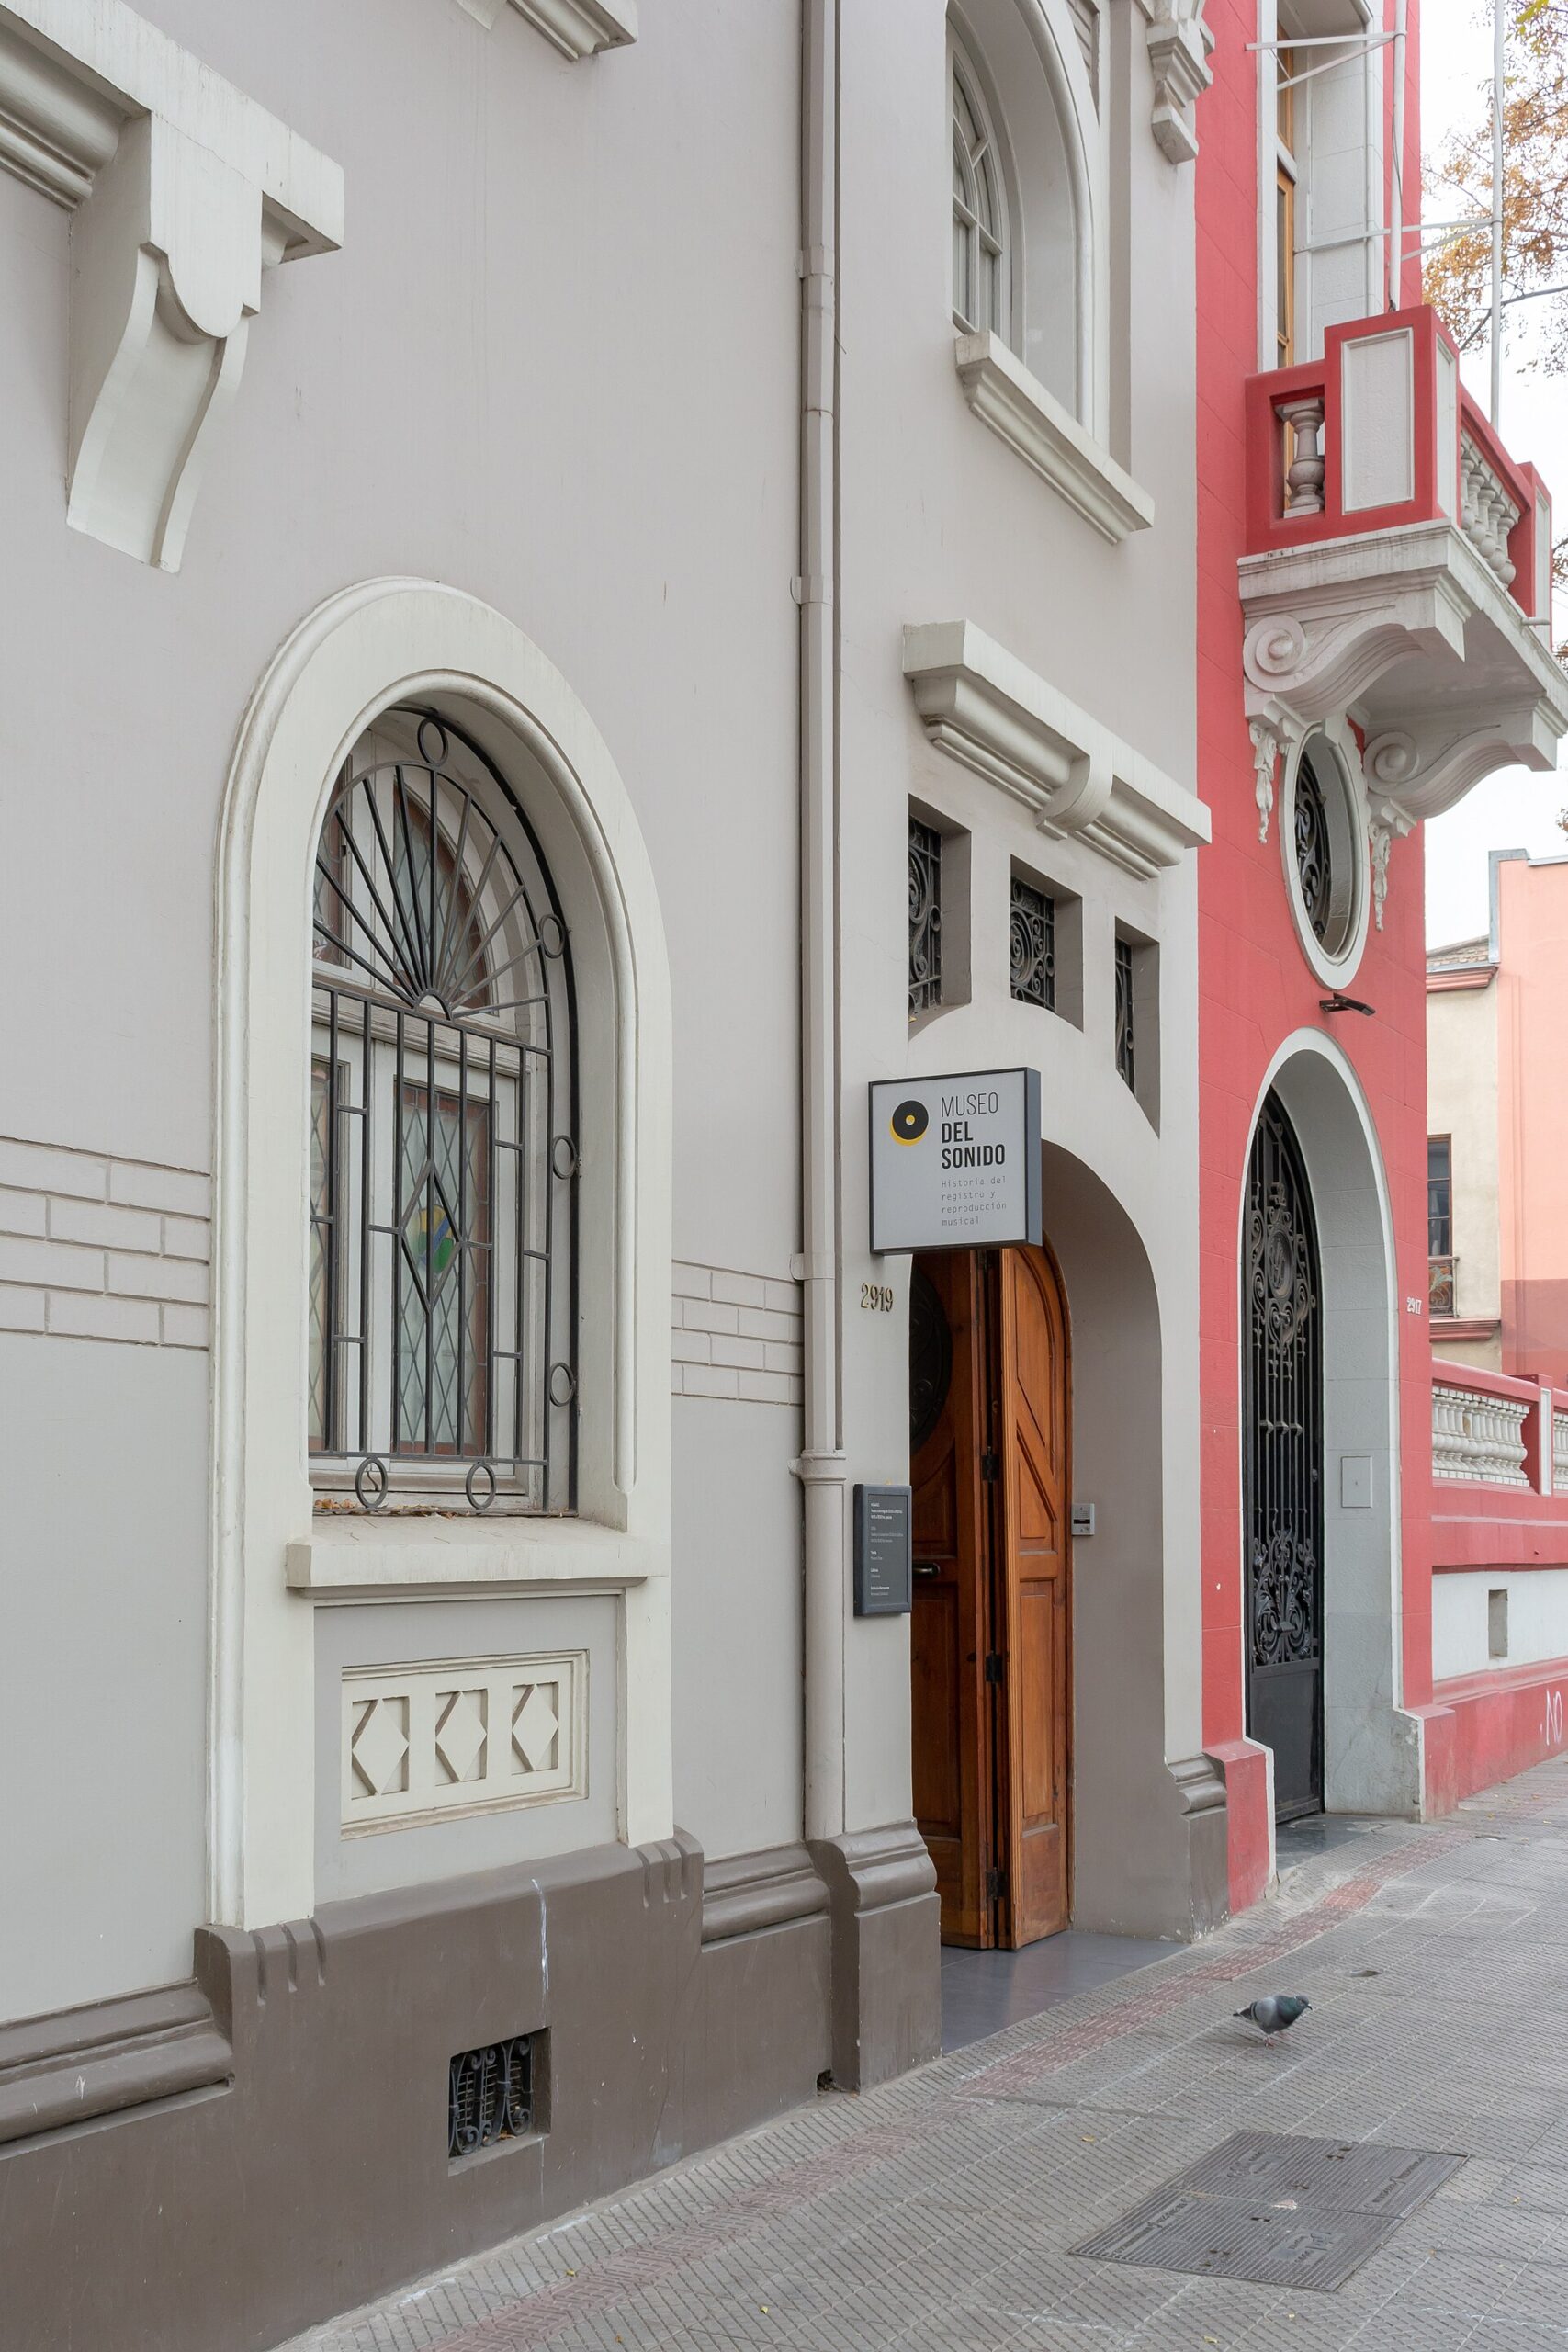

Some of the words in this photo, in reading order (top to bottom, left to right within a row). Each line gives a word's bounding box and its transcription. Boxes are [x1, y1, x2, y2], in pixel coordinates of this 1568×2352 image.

[941, 1091, 998, 1117] MUSEO
[942, 1121, 974, 1144] DEL
[942, 1144, 1006, 1170] SONIDO
[942, 1177, 985, 1188] Historia
[990, 1175, 1007, 1185] del
[942, 1191, 985, 1202] registro
[990, 1191, 997, 1199] y
[942, 1202, 1007, 1214] reproducción
[942, 1216, 979, 1227] musical
[861, 1283, 893, 1312] 2919
